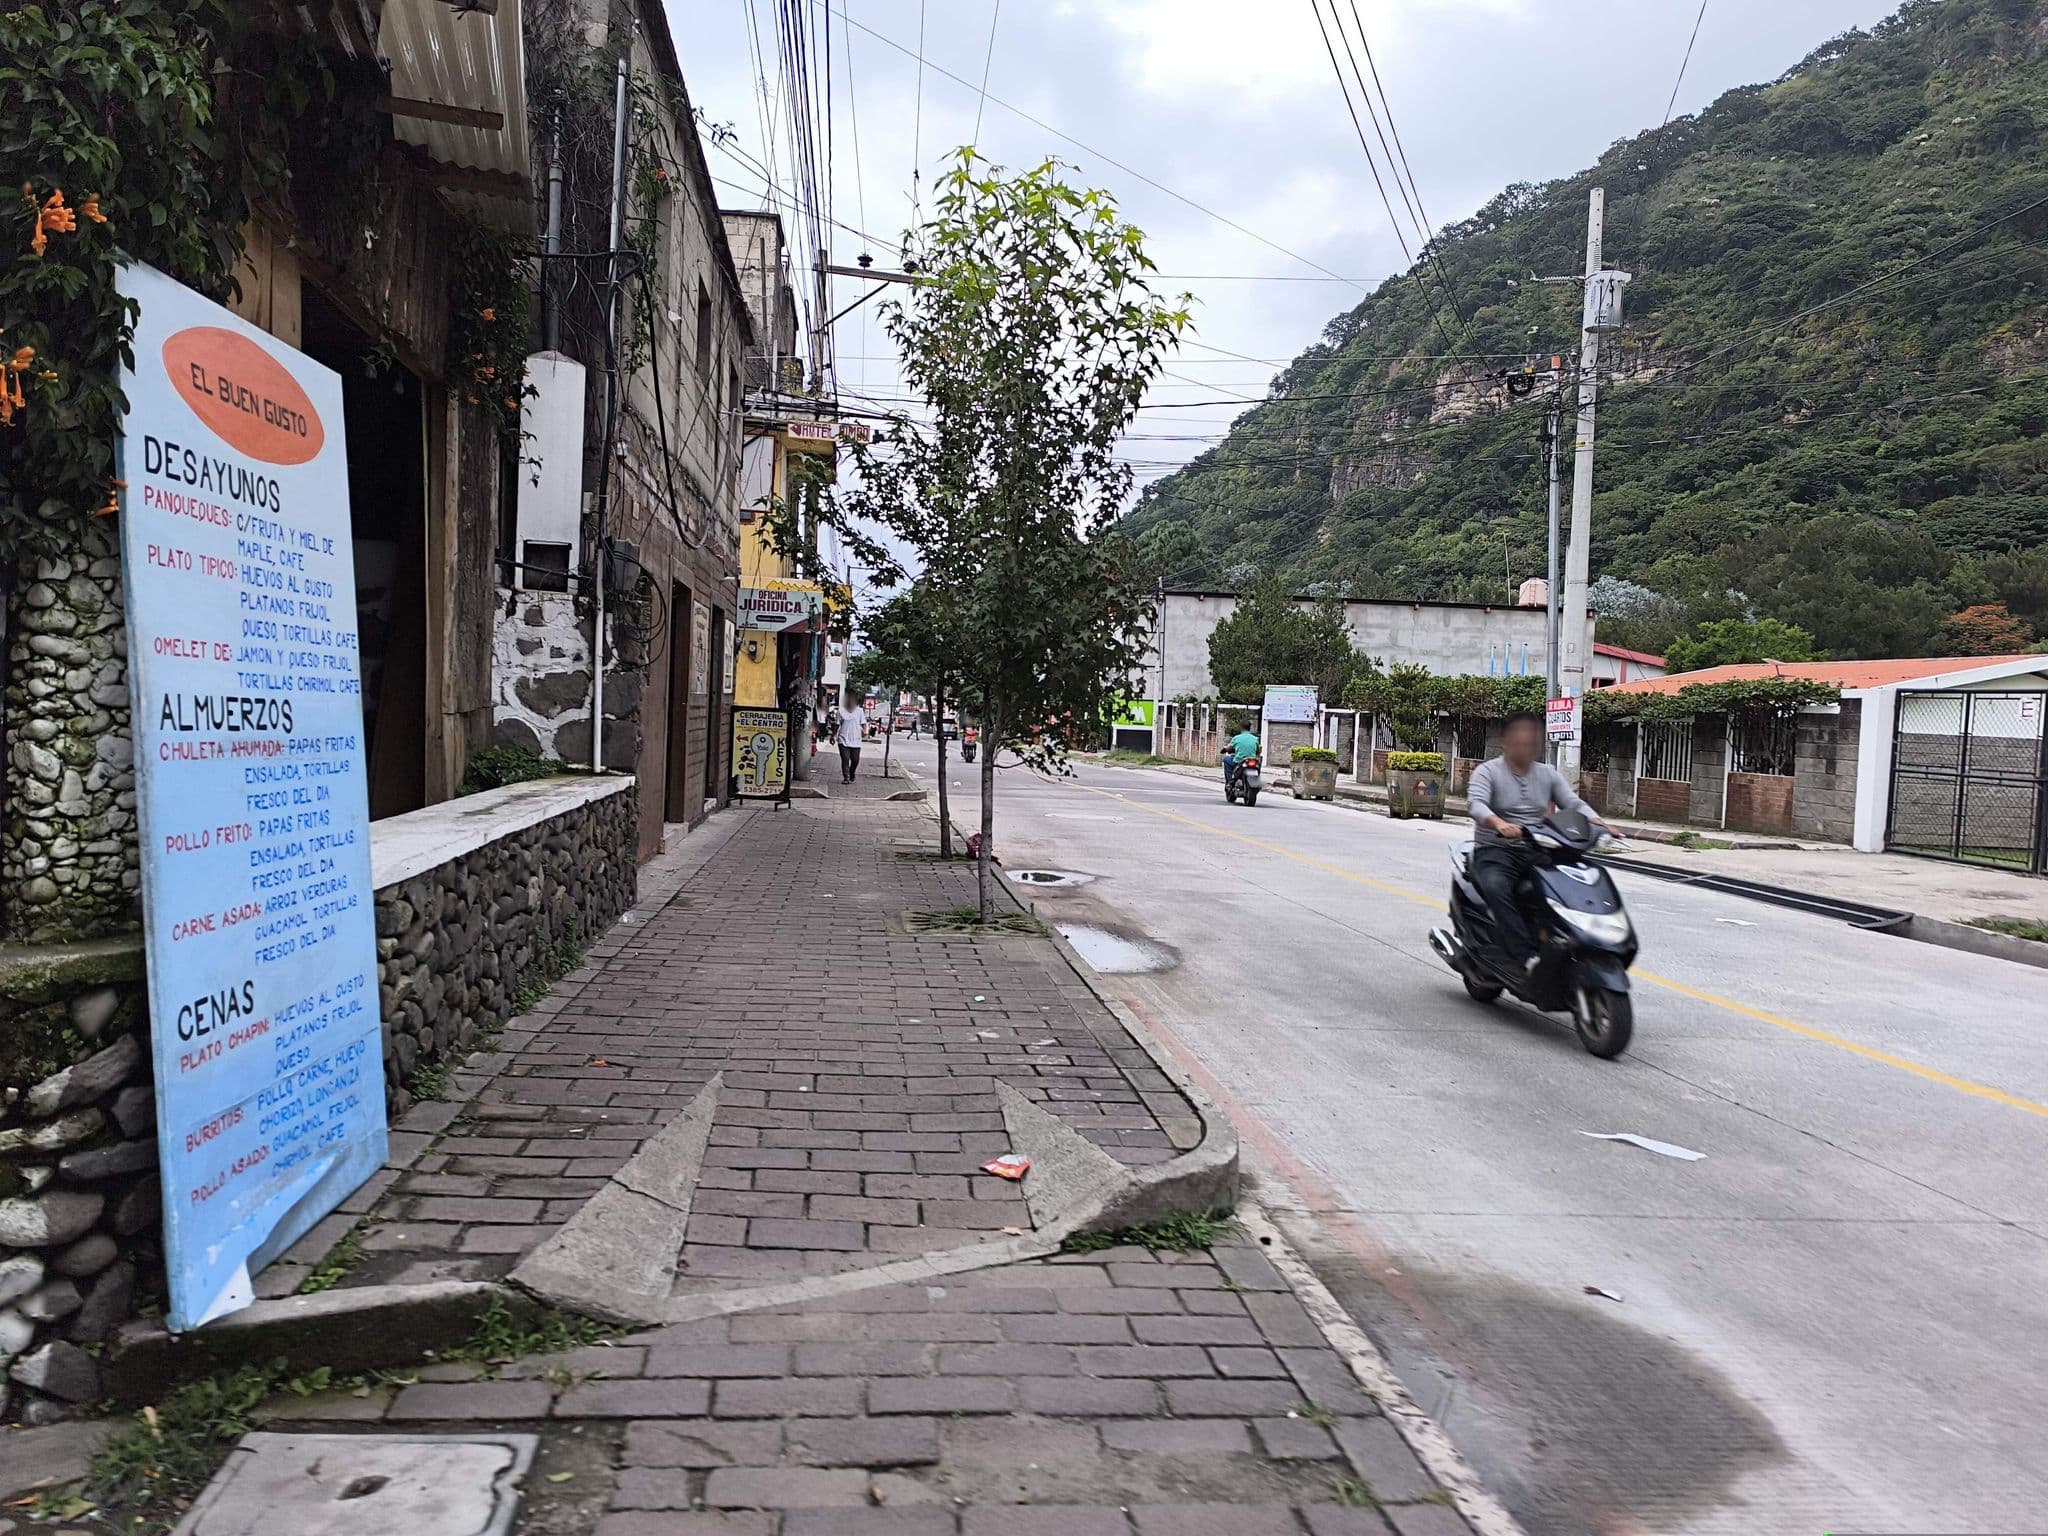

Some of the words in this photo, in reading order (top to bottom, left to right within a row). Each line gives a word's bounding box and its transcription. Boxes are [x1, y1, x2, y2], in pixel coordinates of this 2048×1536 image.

[191, 363, 213, 396] EL
[218, 376, 260, 417] BUEN
[264, 399, 308, 438] GUSTO
[144, 435, 280, 513] DESAYUNOS
[144, 485, 232, 528] PANQUEQUES:
[237, 514, 285, 544] C/FRUTA
[289, 527, 296, 545] Y
[299, 531, 320, 552] MIEL
[322, 538, 335, 556] DE
[148, 544, 193, 571] PLATO
[200, 554, 238, 580] TIPICO:
[241, 564, 283, 590] HUEVOS
[287, 575, 301, 594] AL
[304, 579, 333, 599] GUSTO
[238, 538, 276, 567] MAPLE,
[280, 550, 305, 572] CAFE
[240, 591, 295, 617] PLATANOS
[739, 599, 804, 614] JURIDICA
[758, 591, 788, 601] OFICINA
[154, 637, 207, 659] OMELET
[214, 642, 233, 662] DE:
[236, 646, 273, 665] JAMON
[277, 648, 284, 667] Y
[283, 625, 332, 646] TORTILLAS
[336, 632, 358, 650] CAFE
[237, 671, 294, 691] TORTILLAS
[339, 679, 360, 695] CAFE
[159, 693, 294, 734] ALMUERZOS
[740, 712, 785, 721] CERRAJERIA
[2021, 701, 2034, 718] E
[160, 741, 225, 762] CHULETA
[231, 740, 286, 759] AHUMADA:
[288, 738, 322, 756] PAPAS
[325, 735, 356, 753] FRITAS
[775, 738, 785, 778] KEYS
[304, 760, 351, 778] TORTILLAS
[247, 790, 288, 812] FRESCO
[292, 788, 312, 806] DEL
[316, 785, 330, 801] DIA
[166, 830, 210, 855] POLLO
[216, 823, 253, 846] FRITO:
[259, 815, 292, 838] PAPAS
[297, 809, 330, 831] FRITAS
[308, 830, 355, 854] TORTILLAS
[252, 867, 293, 892] FRESCO
[298, 861, 316, 880] DEL
[320, 858, 335, 874] DIA
[172, 913, 216, 942] CARNE
[222, 902, 263, 928] ASADA:
[264, 891, 298, 915] ARROZ
[301, 874, 348, 902] VERDURAS
[255, 912, 308, 942] GUACAMOL
[312, 894, 358, 922] TORTILLAS
[255, 937, 296, 967] FRESCO
[299, 930, 318, 951] DEL
[321, 925, 337, 943] DIA
[177, 980, 254, 1042] CENAS
[179, 1040, 222, 1075] PLATO
[274, 995, 314, 1028] HUEVOS
[318, 989, 332, 1007] AL
[336, 973, 364, 999] GUSTO
[275, 1013, 328, 1053] PLATANOS
[275, 1046, 310, 1079] QUESO
[185, 1106, 245, 1154] BURRITOS:
[335, 1038, 366, 1069] HUEVO
[317, 1121, 346, 1150] CAFE
[190, 1171, 226, 1209] POLLO
[230, 1143, 271, 1177] ASADO:
[272, 1113, 325, 1153] GUACAMOL
